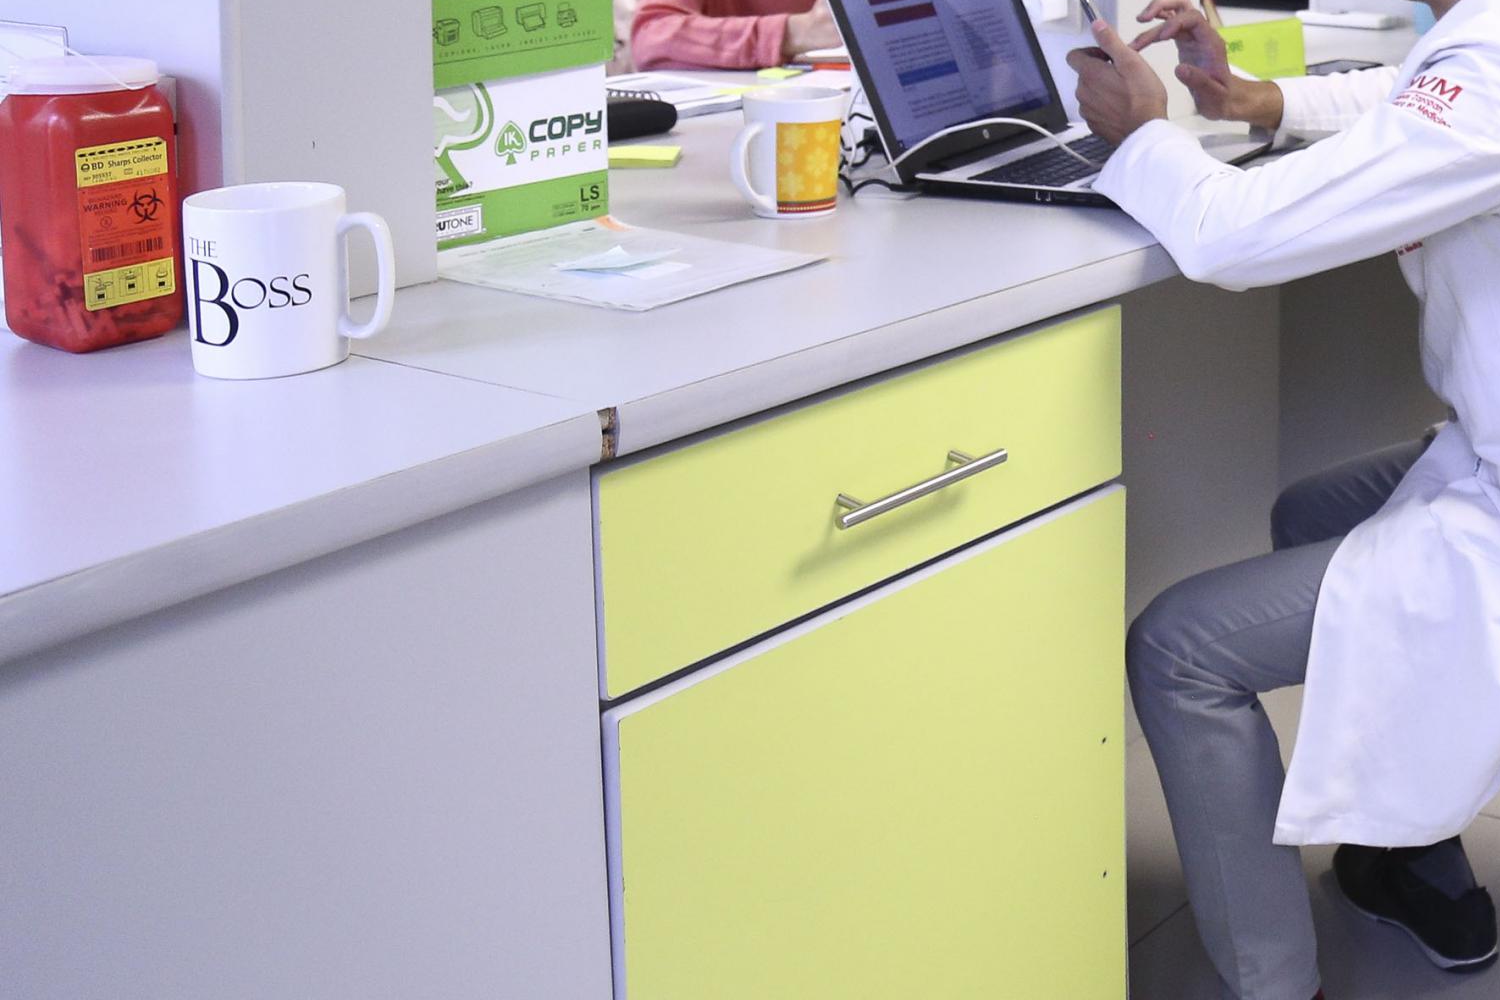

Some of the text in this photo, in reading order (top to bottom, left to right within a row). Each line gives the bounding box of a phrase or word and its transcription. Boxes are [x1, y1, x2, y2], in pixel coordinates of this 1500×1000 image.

[528, 110, 603, 143] COPY
[530, 139, 602, 161] PAPER
[91, 161, 104, 171] BD
[107, 158, 132, 170] Sharps
[132, 153, 163, 165] Collector
[580, 184, 600, 202] LS
[83, 200, 128, 213] WARNING
[189, 236, 218, 258] THE
